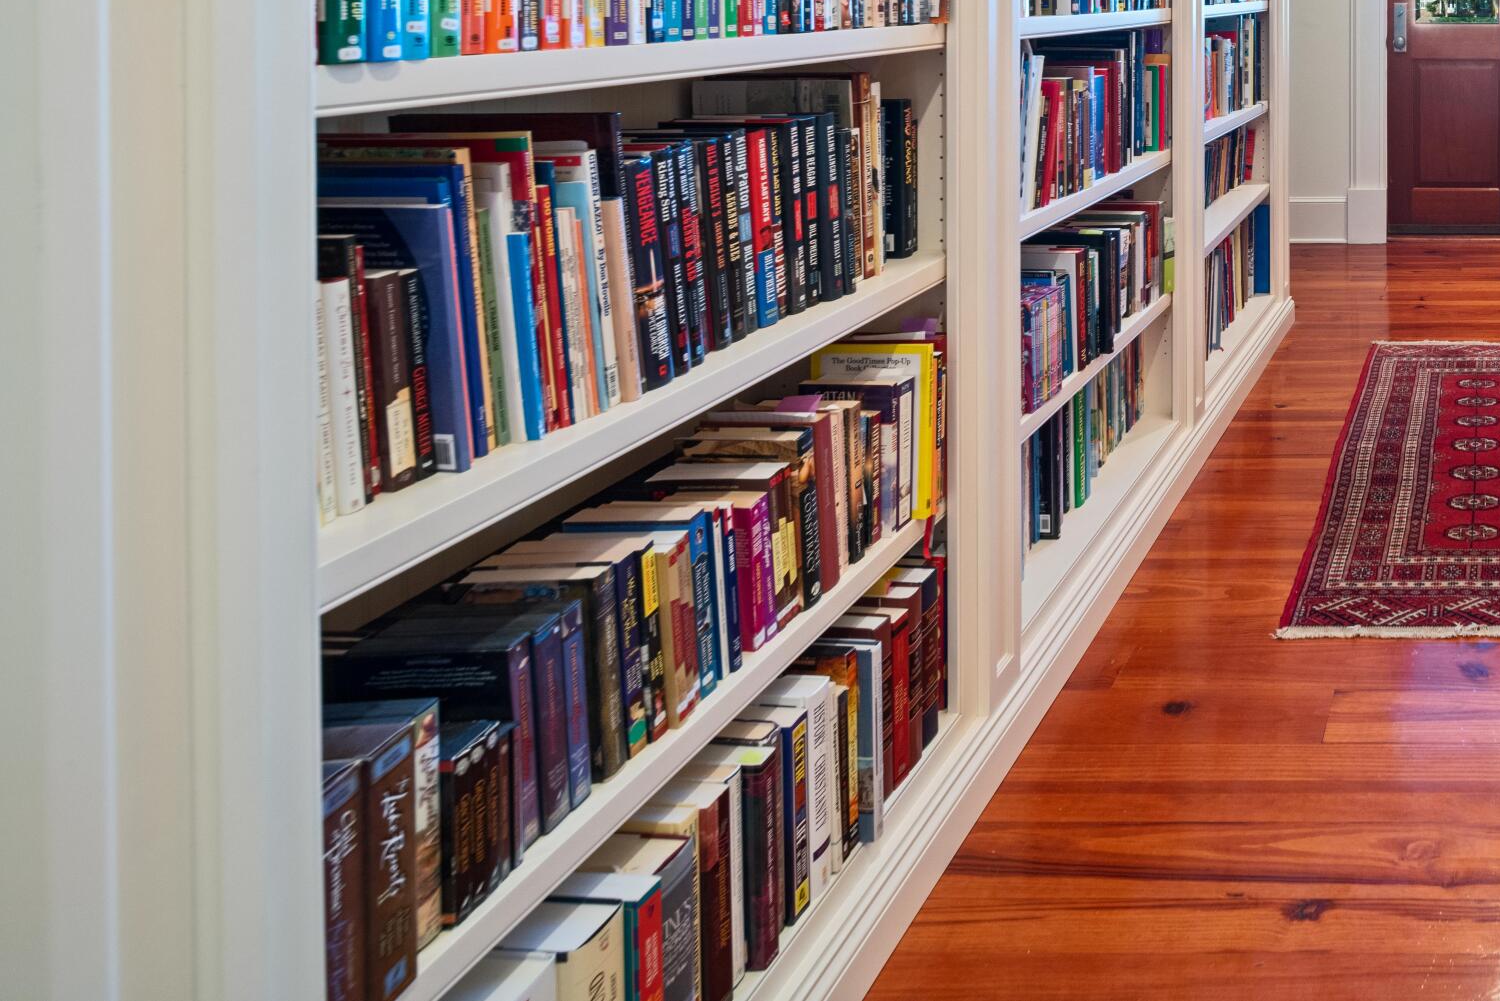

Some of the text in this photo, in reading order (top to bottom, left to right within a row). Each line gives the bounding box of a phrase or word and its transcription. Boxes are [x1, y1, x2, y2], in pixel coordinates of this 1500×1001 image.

[351, 1, 363, 21] COP
[791, 127, 799, 157] KILLING
[806, 126, 816, 187] KILLING REAGAN
[826, 125, 837, 181] KILLING LINCOLN
[735, 135, 750, 208] Killing Patton
[792, 159, 800, 176] THE
[657, 160, 672, 222] Rising Sun
[760, 184, 770, 202] LAST
[845, 169, 853, 206] PILGRIMS
[634, 169, 657, 246] VENGEANCE
[725, 191, 738, 230] LEGENDS
[761, 203, 771, 222] DAYS
[543, 196, 555, 256] 100 WOMEN
[588, 153, 611, 317] CITIZEN LAZLO! By Don Novello
[681, 207, 694, 249] LEGENDS
[714, 221, 723, 247] LEGENDS
[809, 224, 817, 238] BILL
[717, 255, 725, 269] LIES
[729, 241, 740, 262] LIES
[743, 244, 754, 265] BILL
[764, 254, 773, 271] BILL
[673, 264, 682, 284] BILL
[686, 260, 696, 282] LIES
[657, 320, 670, 359] GINGRICH
[408, 278, 433, 456] THE AUTOBIOGRAPHY OF GEORGE MÜLLER
[832, 357, 845, 365] The
[886, 357, 911, 365] Pop-Up
[803, 493, 814, 574] CONSPIRACY
[694, 562, 704, 610] DAUGHTER
[702, 572, 710, 604] NINTH
[700, 635, 709, 673] HAMILTON
[705, 632, 713, 665] BARBARA
[813, 701, 828, 833] HISTORY CHRISTIANITY
